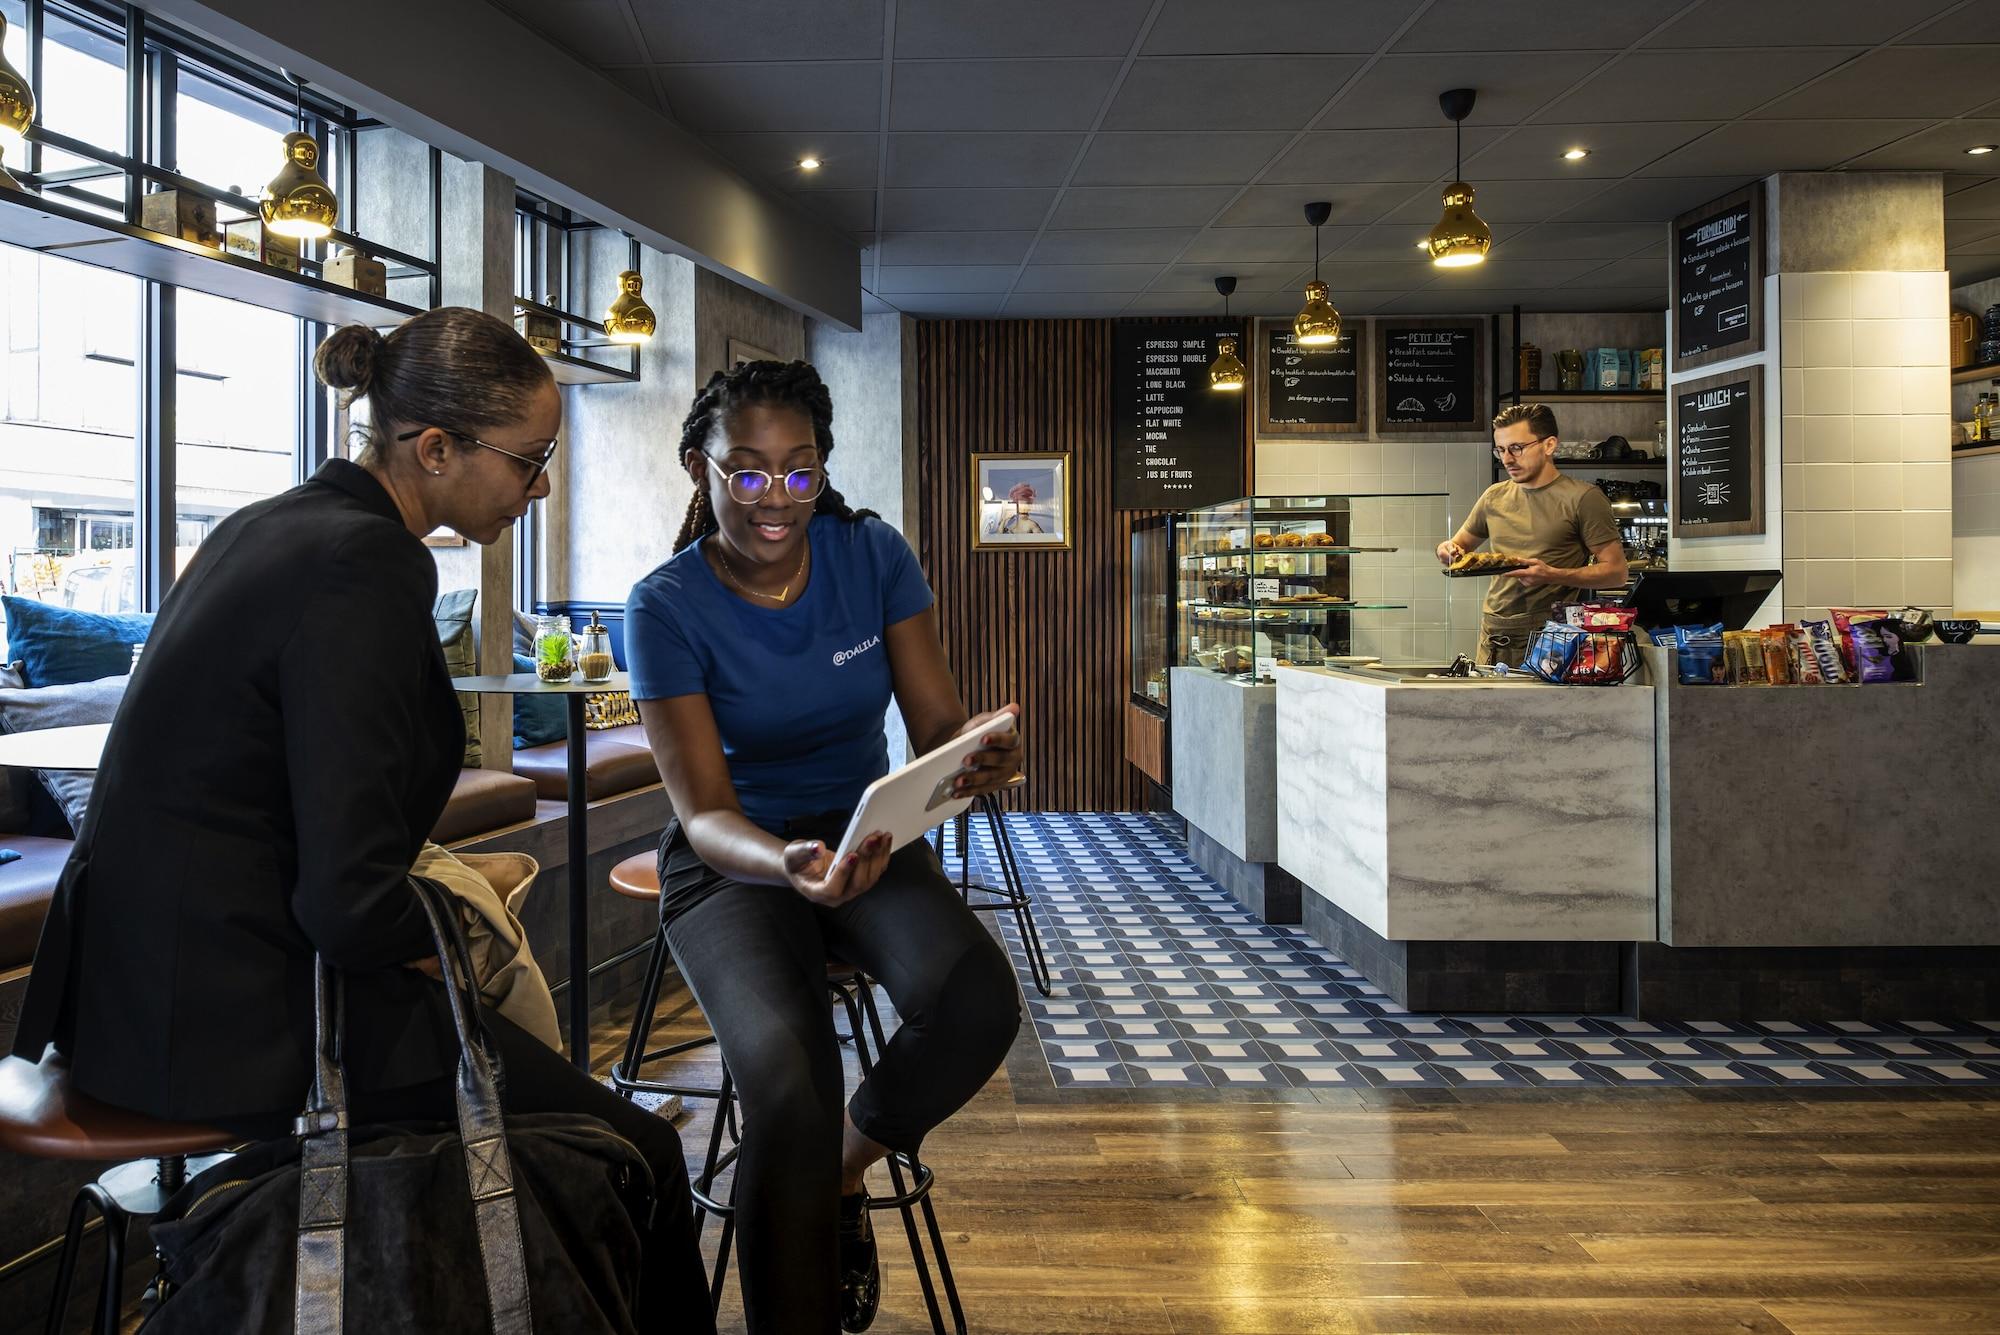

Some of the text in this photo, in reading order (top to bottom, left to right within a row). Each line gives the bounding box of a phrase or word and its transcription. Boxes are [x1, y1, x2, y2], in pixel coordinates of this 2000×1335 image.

[1722, 214, 1737, 233] MIDI
[1408, 333, 1432, 343] PETIT
[1145, 340, 1206, 349] ESPRESSO SIMPLE
[1394, 347, 1426, 356] Breakfast
[1145, 354, 1207, 363] ESPRESSO DOUBLE
[1393, 359, 1420, 367] Granola
[1145, 367, 1181, 376] MACCHIATO
[1393, 374, 1444, 382] Salade de fruits
[1145, 380, 1186, 389] LONG BLACK
[1145, 393, 1165, 402] LATTE
[1697, 388, 1731, 408] LUNCH
[1145, 406, 1183, 415] CAPPUCCINO
[1145, 419, 1182, 428] FLAT WHITE
[1686, 420, 1707, 433] Sandwich
[1145, 432, 1167, 440] MOCHA
[1145, 445, 1157, 453] THE
[1145, 458, 1177, 466] CHOCOLAT
[1146, 470, 1192, 479] JUS DE FRUITS
[832, 635, 881, 666] @DALILA
